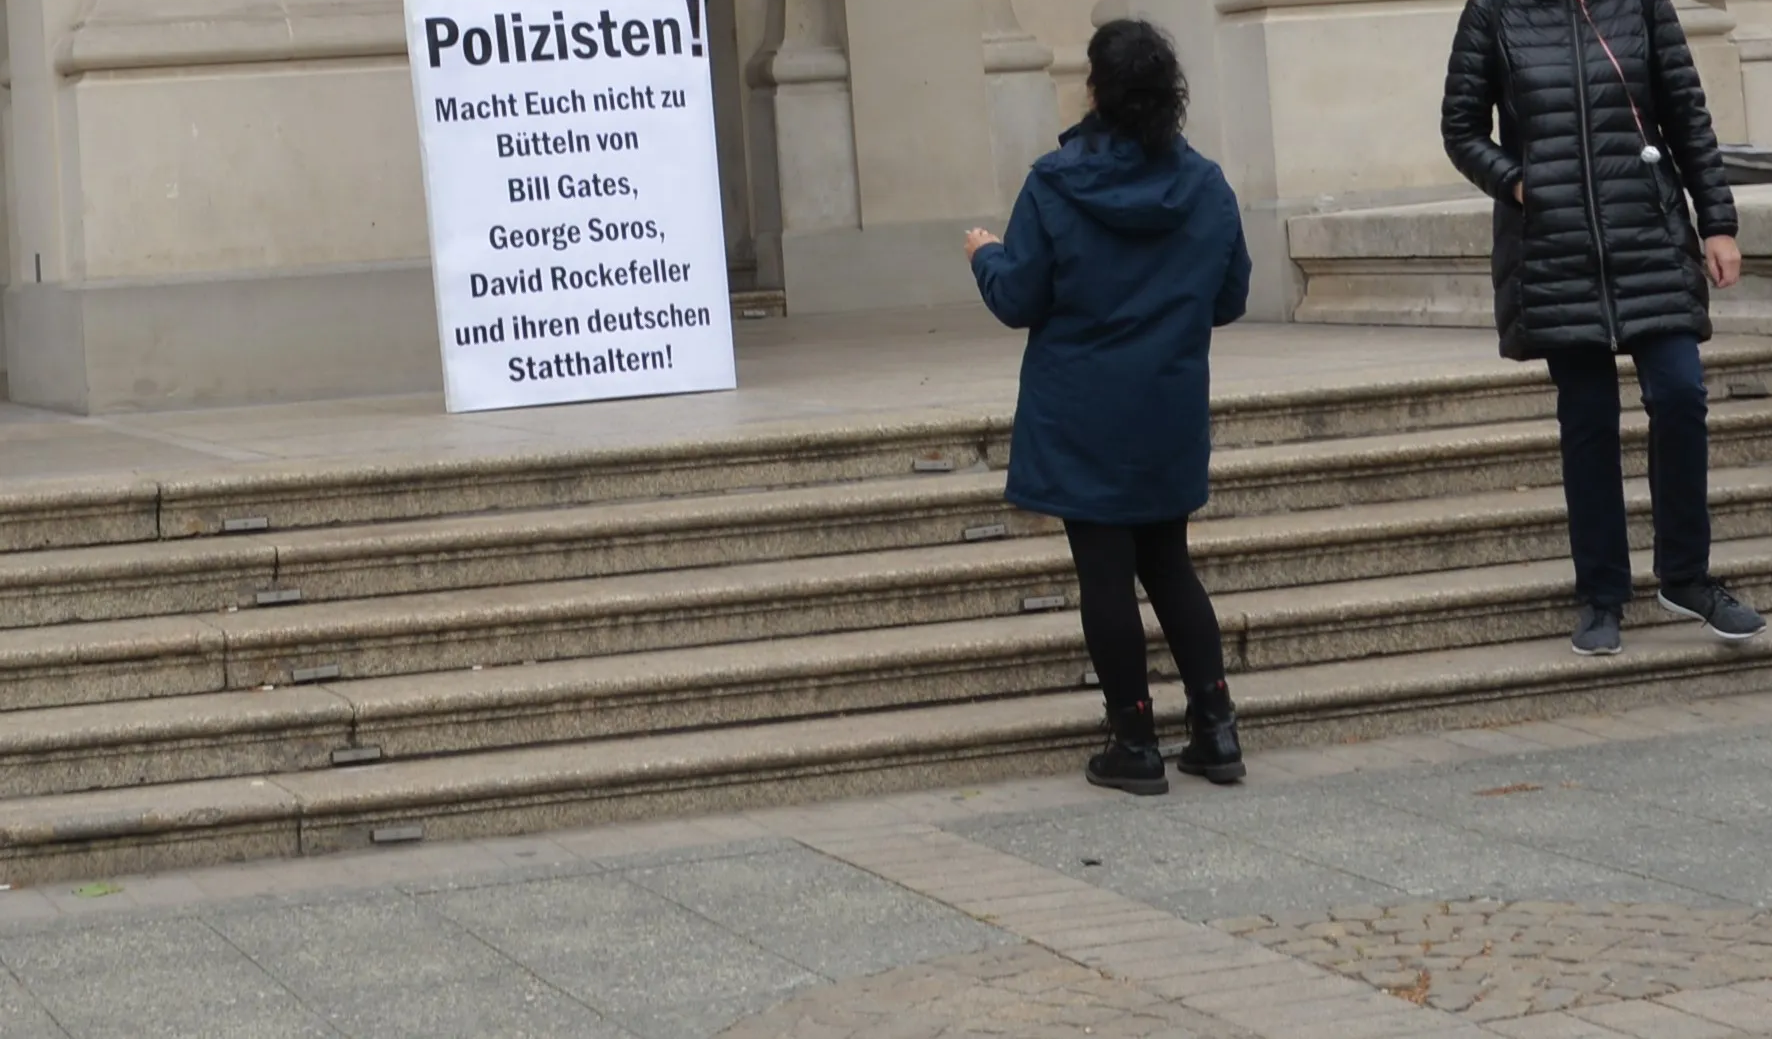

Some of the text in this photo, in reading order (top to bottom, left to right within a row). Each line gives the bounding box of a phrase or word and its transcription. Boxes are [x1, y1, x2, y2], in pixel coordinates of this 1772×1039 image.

[435, 86, 687, 122] Macht Euch nicht zu
[496, 129, 639, 158] Bütteln von
[507, 173, 639, 203] Bill Gates,
[488, 217, 666, 251] George Soros,
[470, 258, 691, 299] David Rockefeller
[455, 303, 711, 347] und ihren deutschen
[508, 344, 674, 382] Statthaltern!
